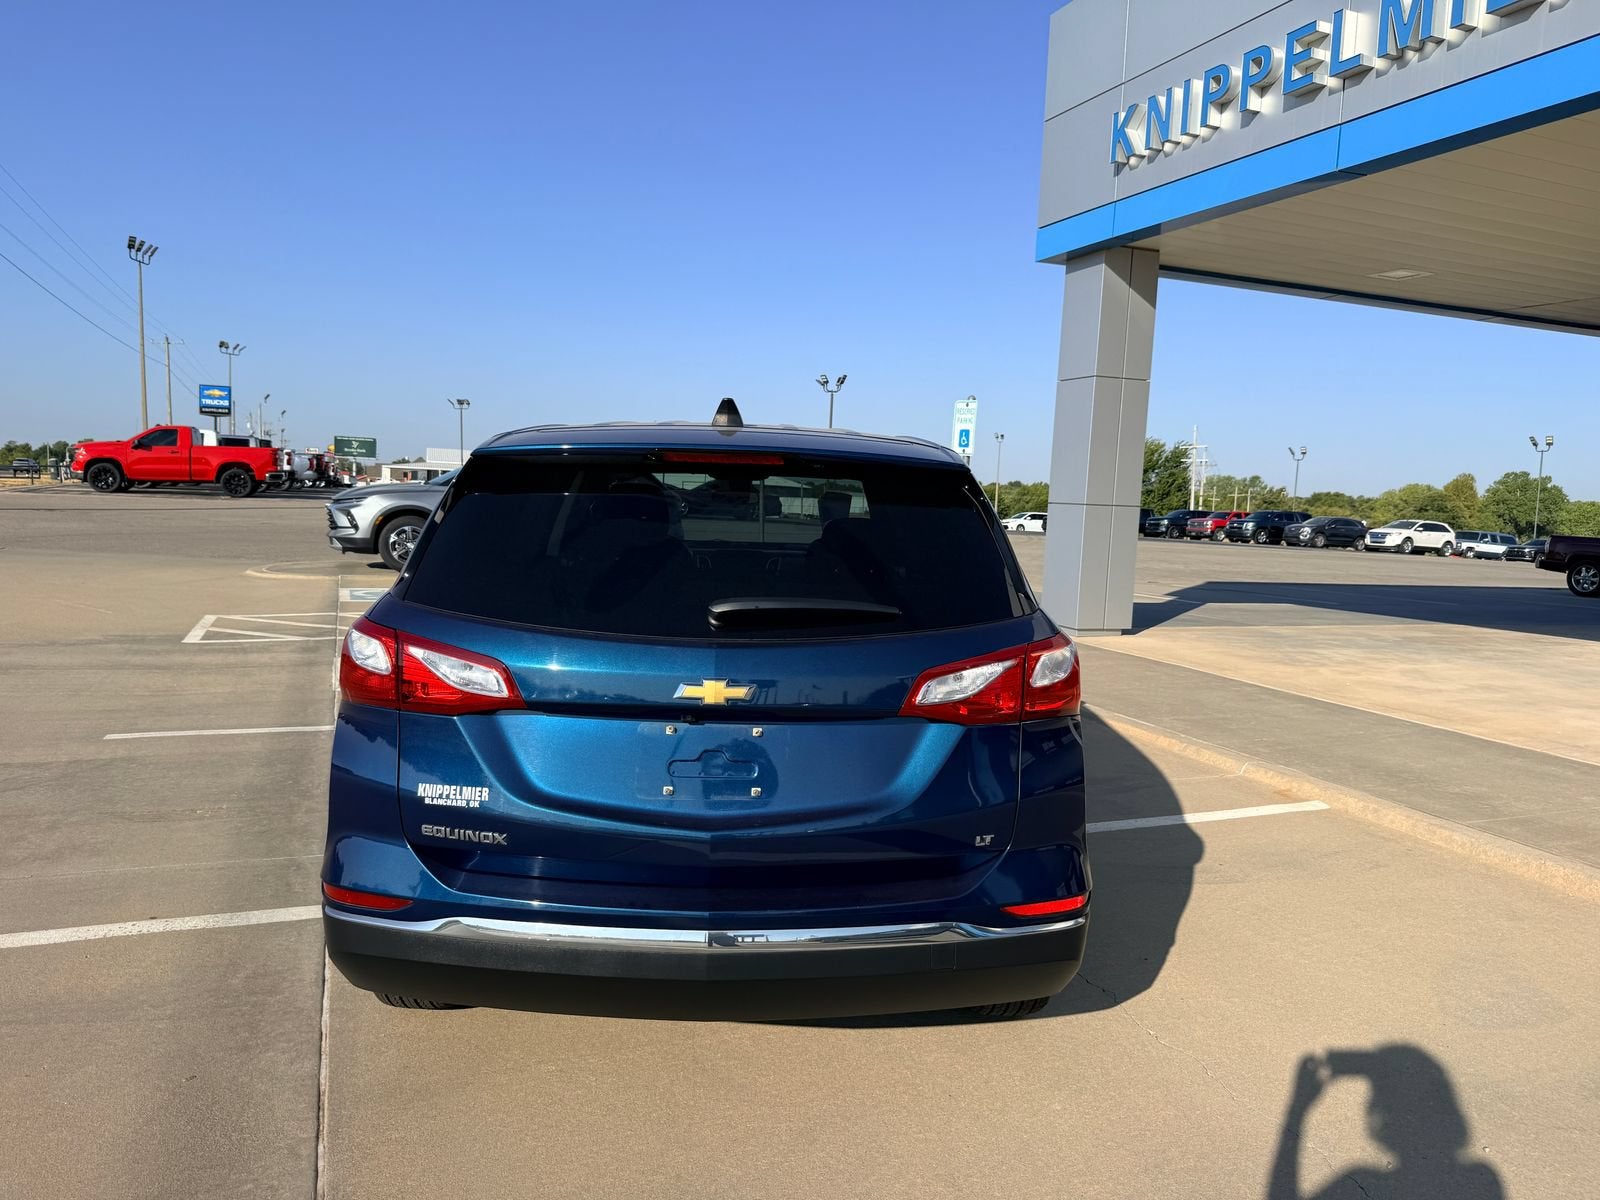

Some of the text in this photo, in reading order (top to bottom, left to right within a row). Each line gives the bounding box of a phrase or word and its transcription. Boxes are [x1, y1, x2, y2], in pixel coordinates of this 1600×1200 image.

[201, 398, 230, 406] TRUCKS
[417, 783, 490, 802] KNIPPELMIER
[424, 797, 480, 808] BLANCHARD, OK
[421, 824, 508, 845] EQUINOX
[975, 834, 995, 847] LT
